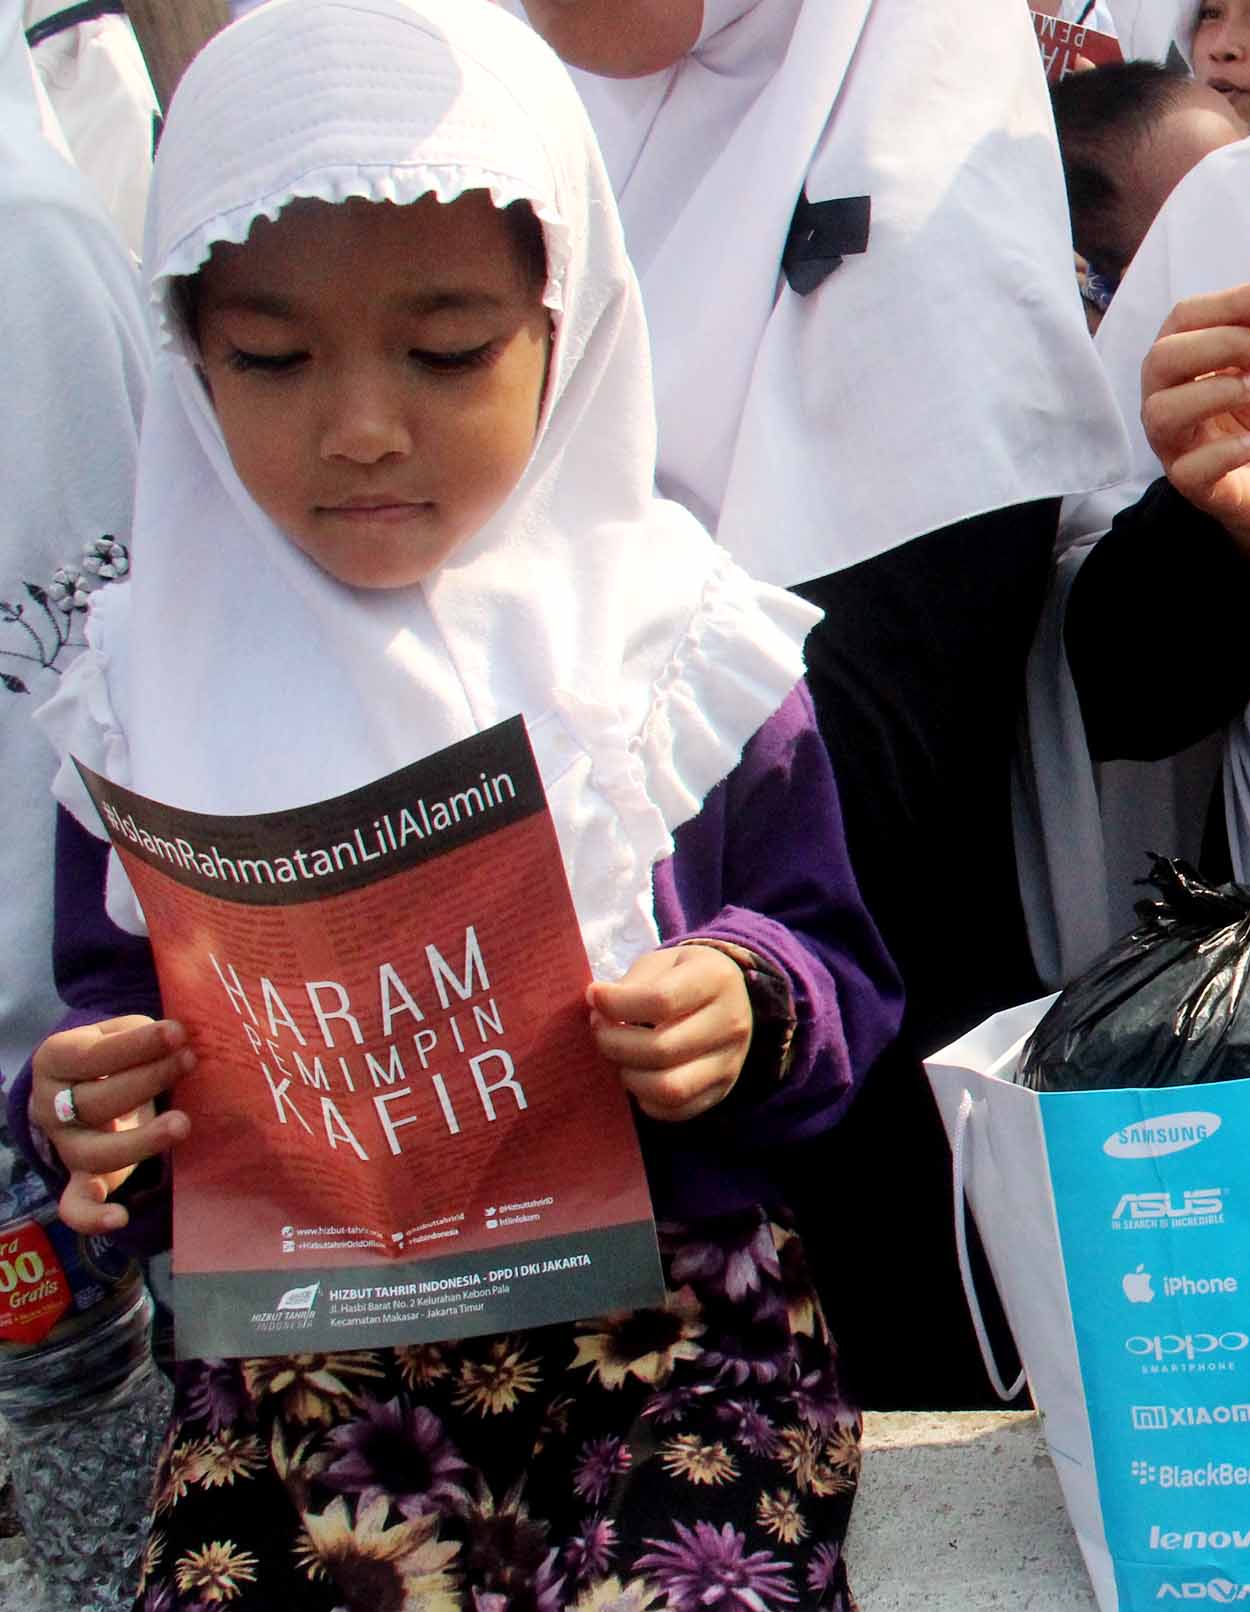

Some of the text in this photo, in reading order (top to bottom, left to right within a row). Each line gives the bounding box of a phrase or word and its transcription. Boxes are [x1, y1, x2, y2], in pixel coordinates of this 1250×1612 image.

[101, 771, 517, 886] #IslamRahmatanLilAlamin
[209, 925, 491, 1049] HARAM
[244, 998, 505, 1092] PEMIMPIN
[261, 1048, 528, 1161] KAFIR
[1118, 1125, 1208, 1145] SAMSUNG
[1112, 1188, 1224, 1219] ASUS
[330, 1288, 372, 1301] HIZBUT
[375, 1284, 416, 1298] TAHRIR
[419, 1274, 481, 1294] INDONESIA
[489, 1268, 513, 1283] DPD
[521, 1264, 540, 1277] DKI
[541, 1254, 591, 1273] JAKARTA
[1163, 1276, 1238, 1297] iPhone
[9, 1280, 58, 1309] Gratis
[341, 1303, 366, 1313] Hasbi
[368, 1301, 391, 1312] Barat
[393, 1299, 408, 1309] No.
[409, 1299, 415, 1307] 2
[417, 1294, 461, 1307] Kelurahan
[463, 1288, 491, 1299] Kebon
[492, 1285, 510, 1296] Pala
[251, 1312, 283, 1322] HIZBUT
[330, 1315, 381, 1327] Kecamatan
[383, 1311, 419, 1324] Makasar
[426, 1306, 458, 1319] Jakarta
[459, 1303, 485, 1314] Timur
[1142, 1362, 1235, 1374] SMARTPHONE
